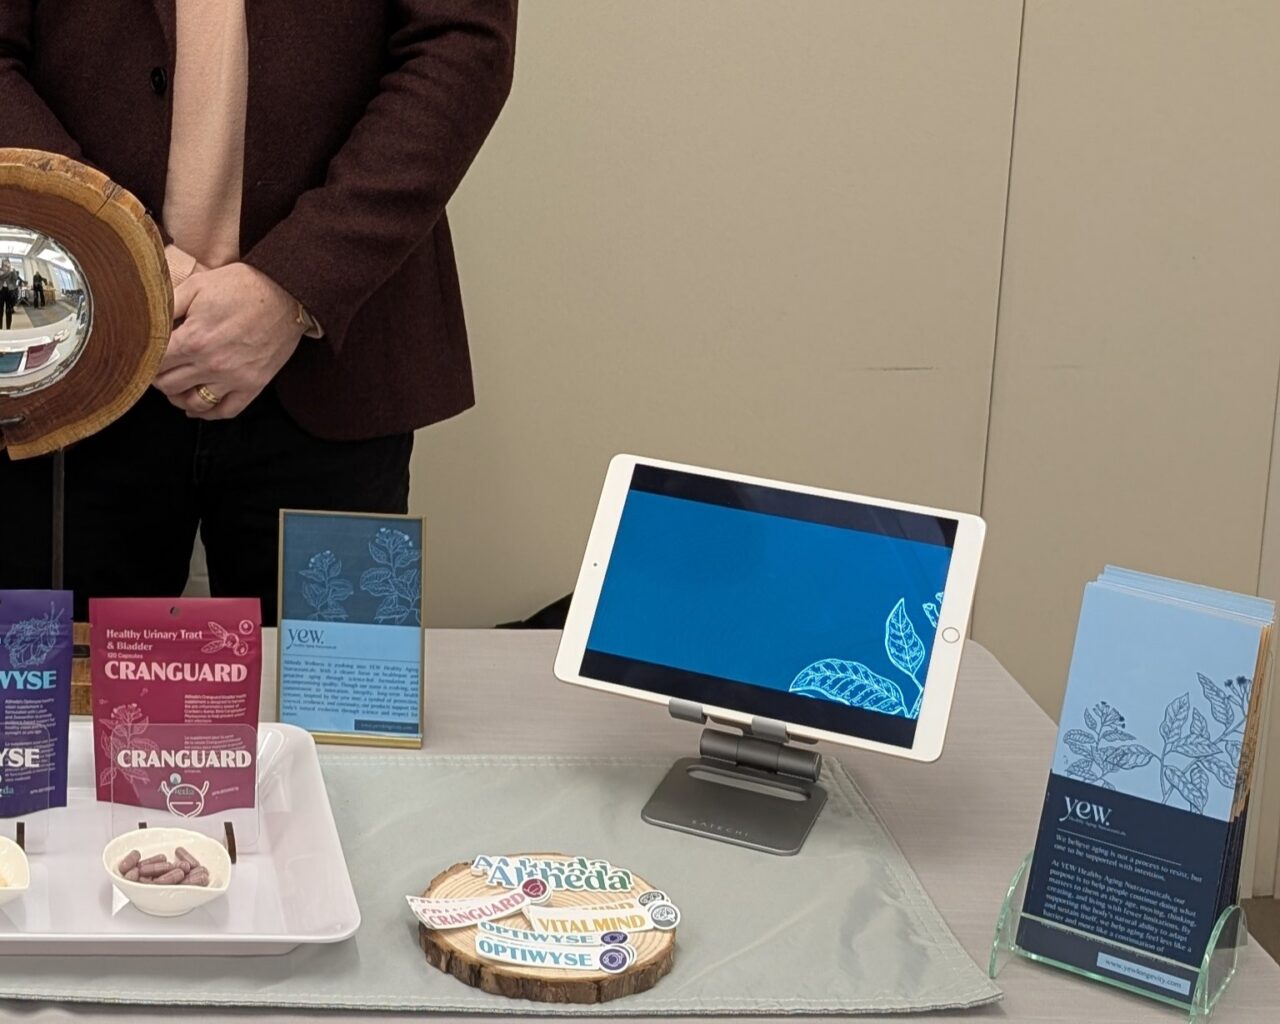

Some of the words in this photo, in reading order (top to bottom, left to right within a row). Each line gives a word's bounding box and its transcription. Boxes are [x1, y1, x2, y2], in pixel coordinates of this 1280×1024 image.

[106, 629, 141, 640] Healthy
[143, 629, 177, 641] Urinary
[180, 629, 203, 640] Tract
[107, 641, 114, 650] &
[116, 641, 153, 651] Bladder
[286, 628, 324, 650] yew.
[104, 660, 248, 683] CRANGUARD
[117, 749, 252, 768] CRANGUARD
[1059, 796, 1112, 826] yew.
[1068, 837, 1090, 849] believe
[1091, 846, 1109, 856] aging
[1190, 873, 1202, 883] but
[1118, 863, 1133, 872] with
[1078, 867, 1102, 880] Healthy
[1104, 875, 1123, 887] Aging
[1082, 887, 1099, 896] them
[1109, 895, 1123, 905] they
[1091, 880, 1105, 890] help
[1106, 886, 1129, 897] people
[1159, 901, 1178, 913] doing
[1179, 908, 1196, 917] what
[429, 892, 526, 926] CRANGUARD
[538, 915, 646, 933] VITALMIND
[1080, 904, 1091, 912] the
[1168, 933, 1187, 943] adapt
[1111, 921, 1125, 932] help
[1126, 928, 1144, 938] aging
[1174, 941, 1186, 950] like
[478, 940, 593, 967] OPTIWYSE
